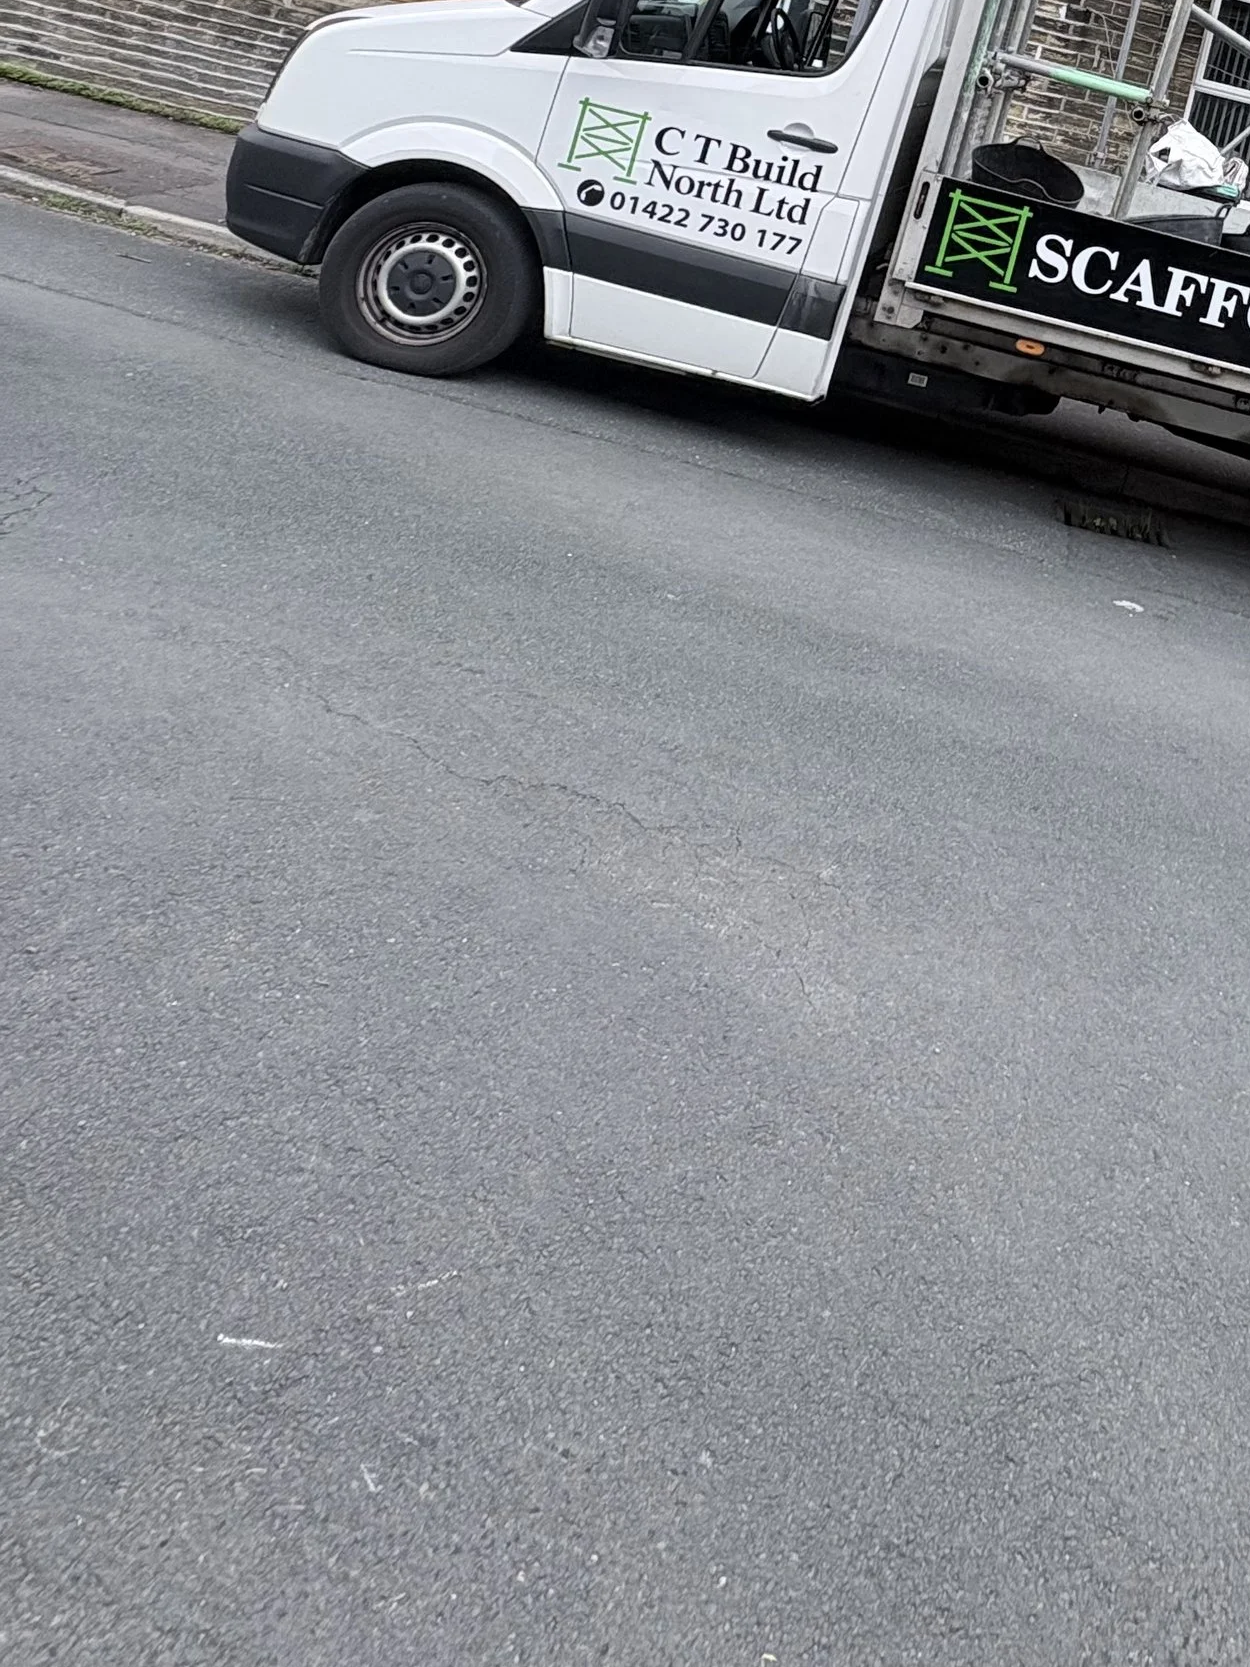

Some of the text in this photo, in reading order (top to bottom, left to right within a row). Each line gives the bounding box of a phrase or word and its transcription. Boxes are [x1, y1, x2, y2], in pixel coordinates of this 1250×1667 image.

[645, 159, 811, 225] North Ltd
[724, 142, 823, 193] Build
[609, 191, 803, 255] 01422 730 177
